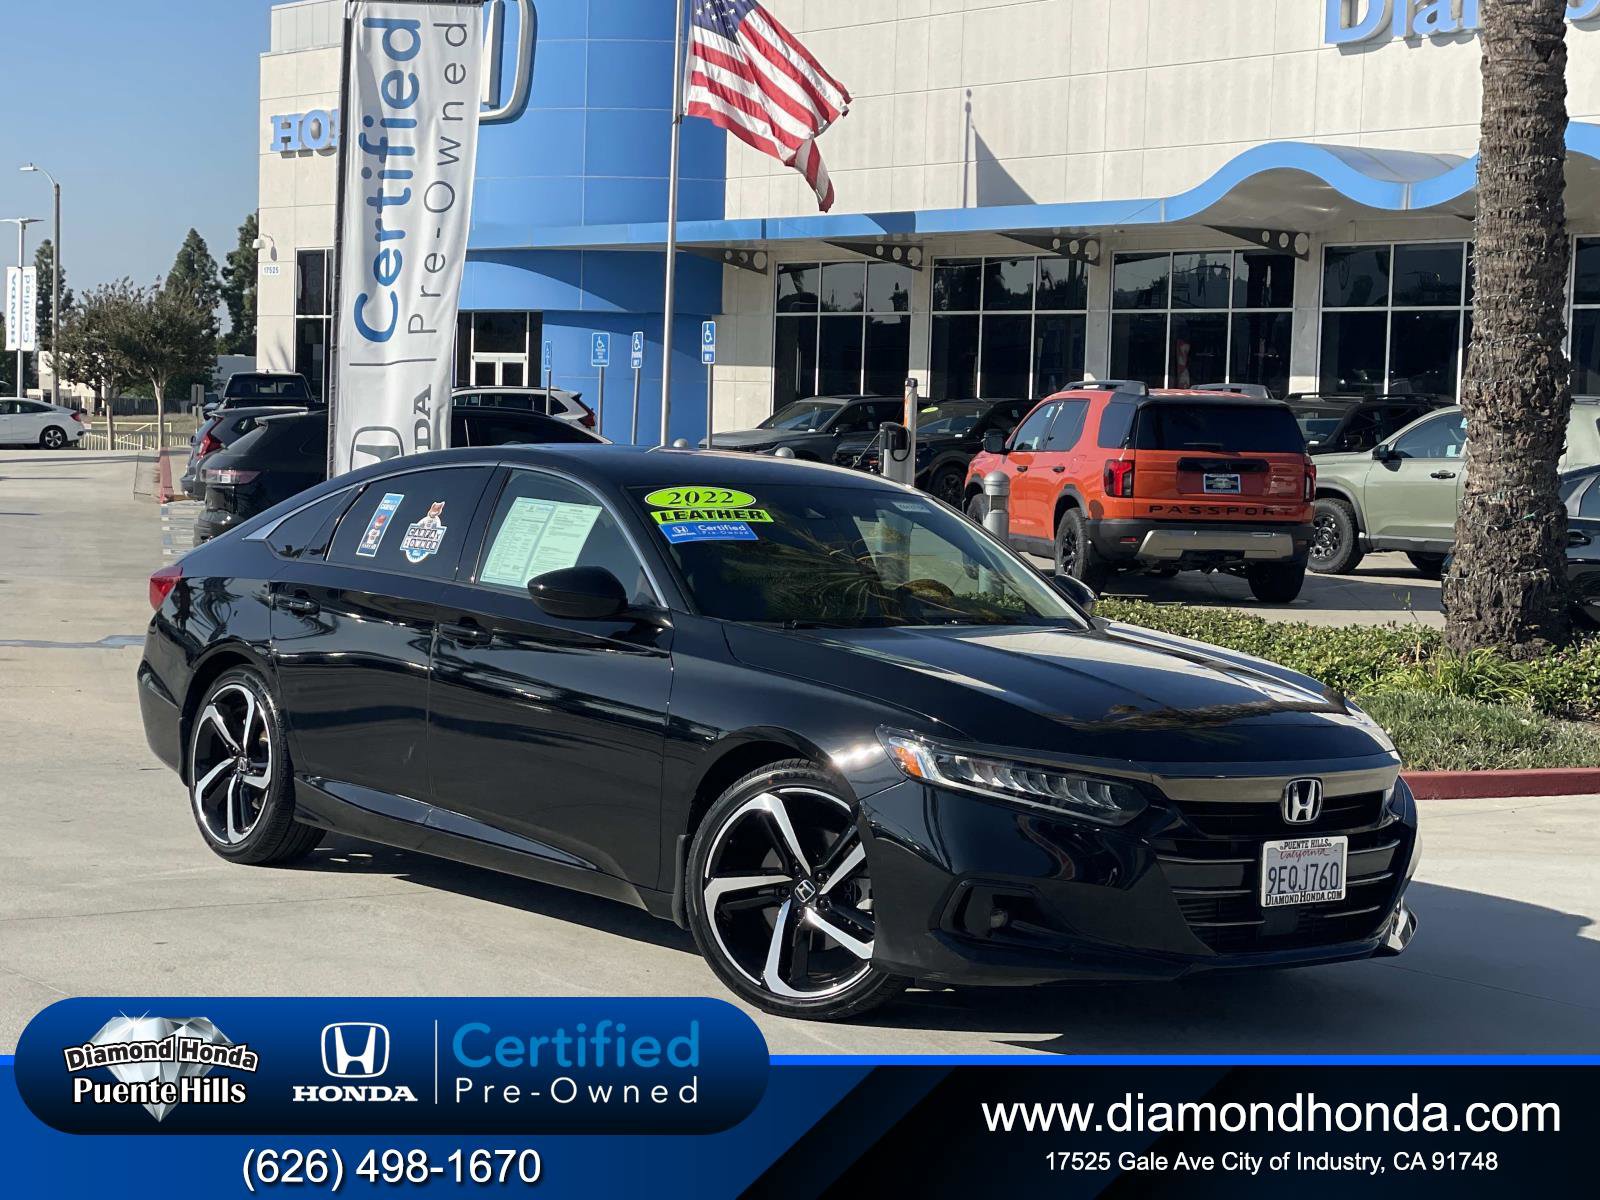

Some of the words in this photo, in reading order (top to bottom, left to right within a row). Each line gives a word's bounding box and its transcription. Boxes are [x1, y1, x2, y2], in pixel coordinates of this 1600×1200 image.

[354, 18, 421, 342] Certified
[408, 23, 467, 334] Pre-Owned
[413, 384, 431, 453] DA
[667, 490, 733, 506] 2022
[660, 509, 764, 521] LEATHER
[1148, 505, 1294, 516] PASSPORT
[1283, 840, 1309, 850] PUENTE
[1310, 838, 1329, 848] HILLS
[1268, 862, 1340, 894] 9EQJ760
